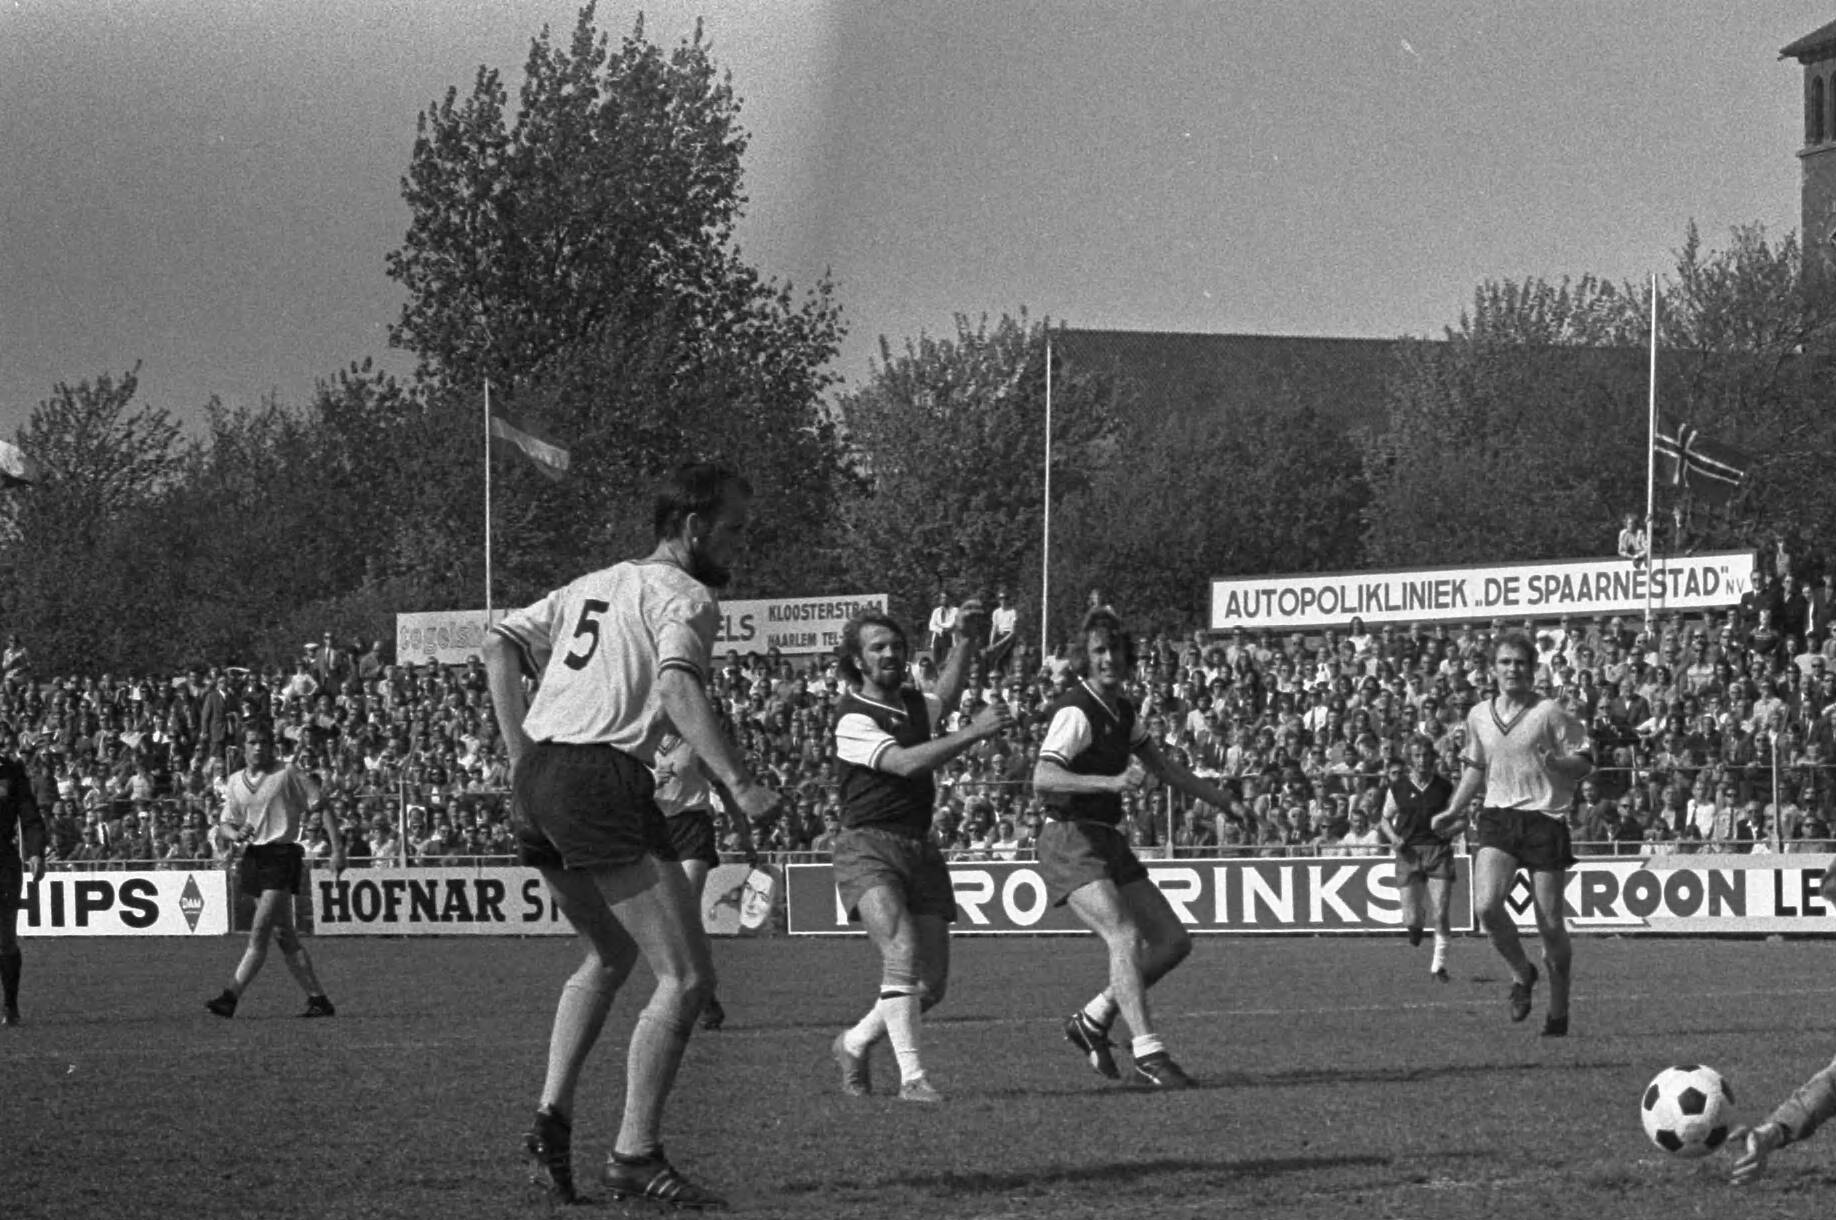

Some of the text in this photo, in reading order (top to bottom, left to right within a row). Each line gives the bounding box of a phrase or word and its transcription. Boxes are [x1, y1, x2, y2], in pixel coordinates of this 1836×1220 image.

[1225, 579, 1468, 619] AUTOPOLIKLINIEK
[563, 599, 610, 671] 5
[319, 879, 506, 923] HOFNAR
[1147, 863, 1404, 924] RINKS
